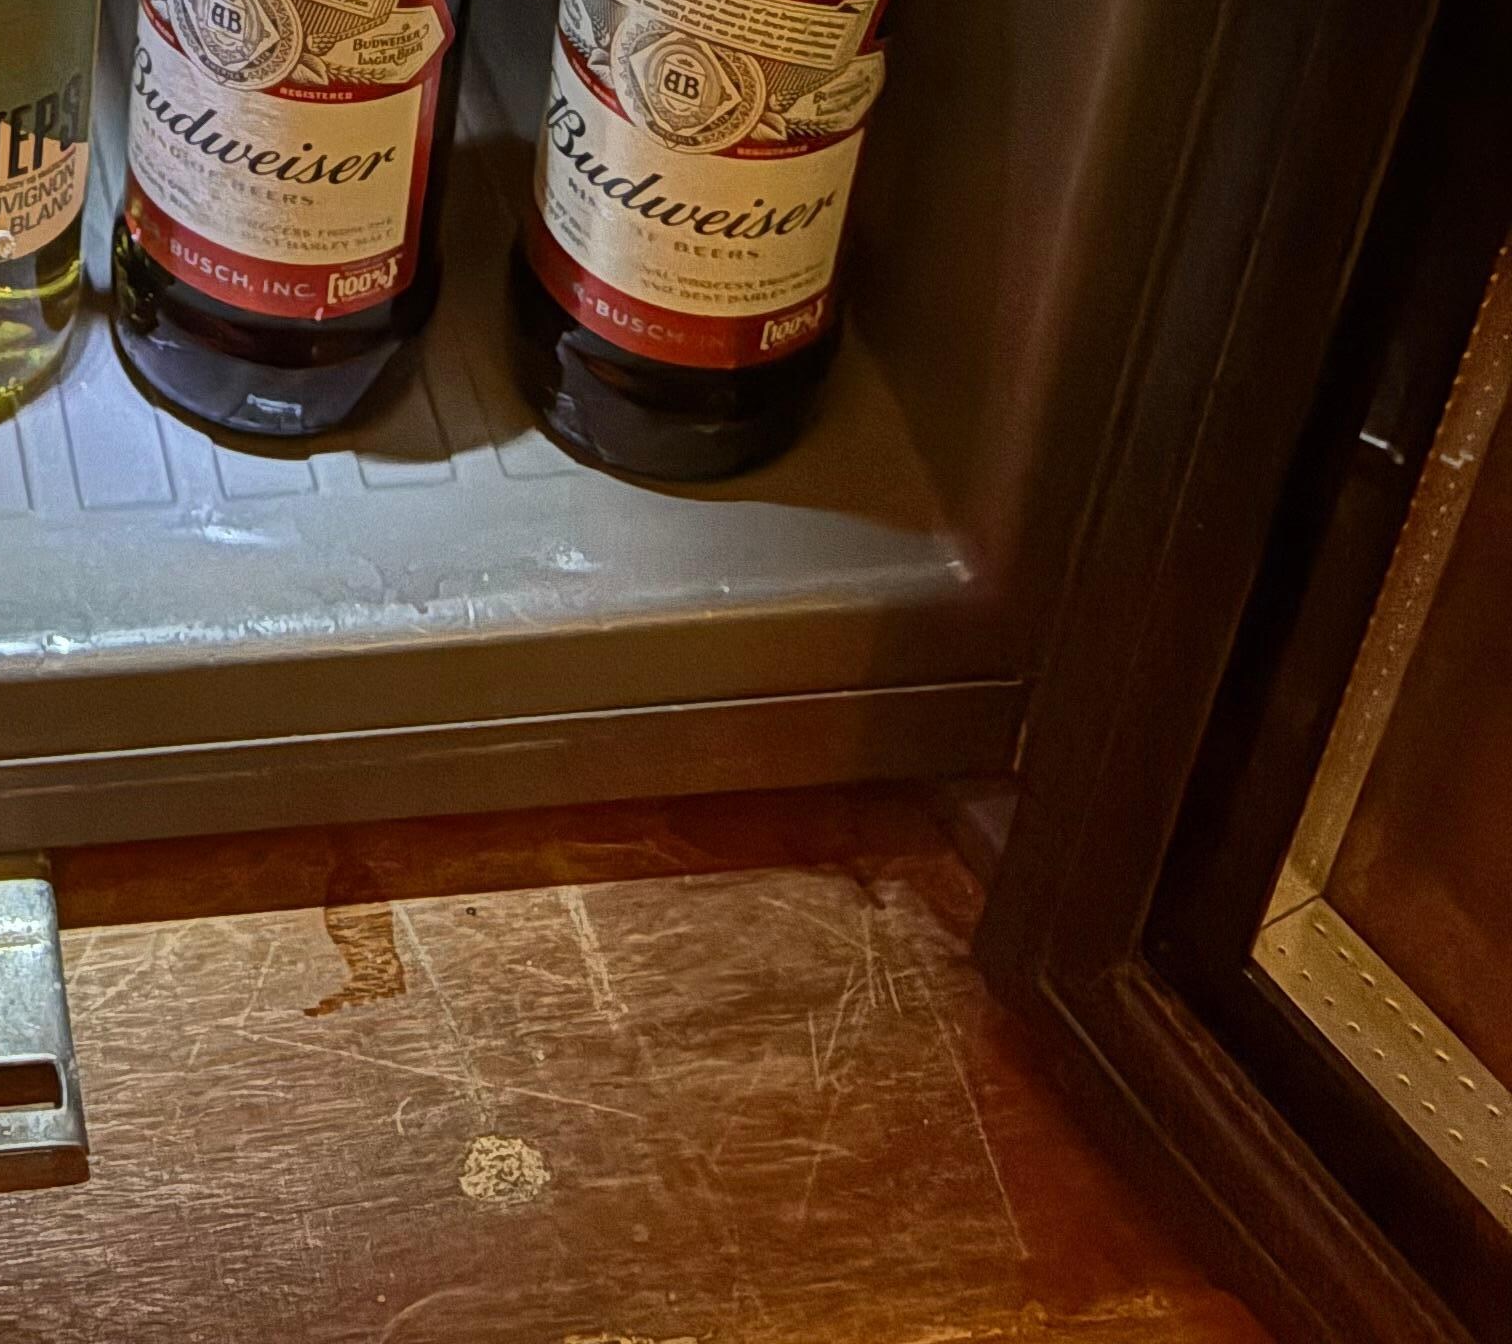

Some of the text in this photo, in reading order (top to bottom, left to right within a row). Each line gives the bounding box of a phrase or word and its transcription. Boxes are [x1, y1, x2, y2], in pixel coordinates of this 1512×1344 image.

[134, 47, 395, 184] Budweiser
[547, 80, 836, 240] Budweiser
[9, 183, 75, 236] BLANC
